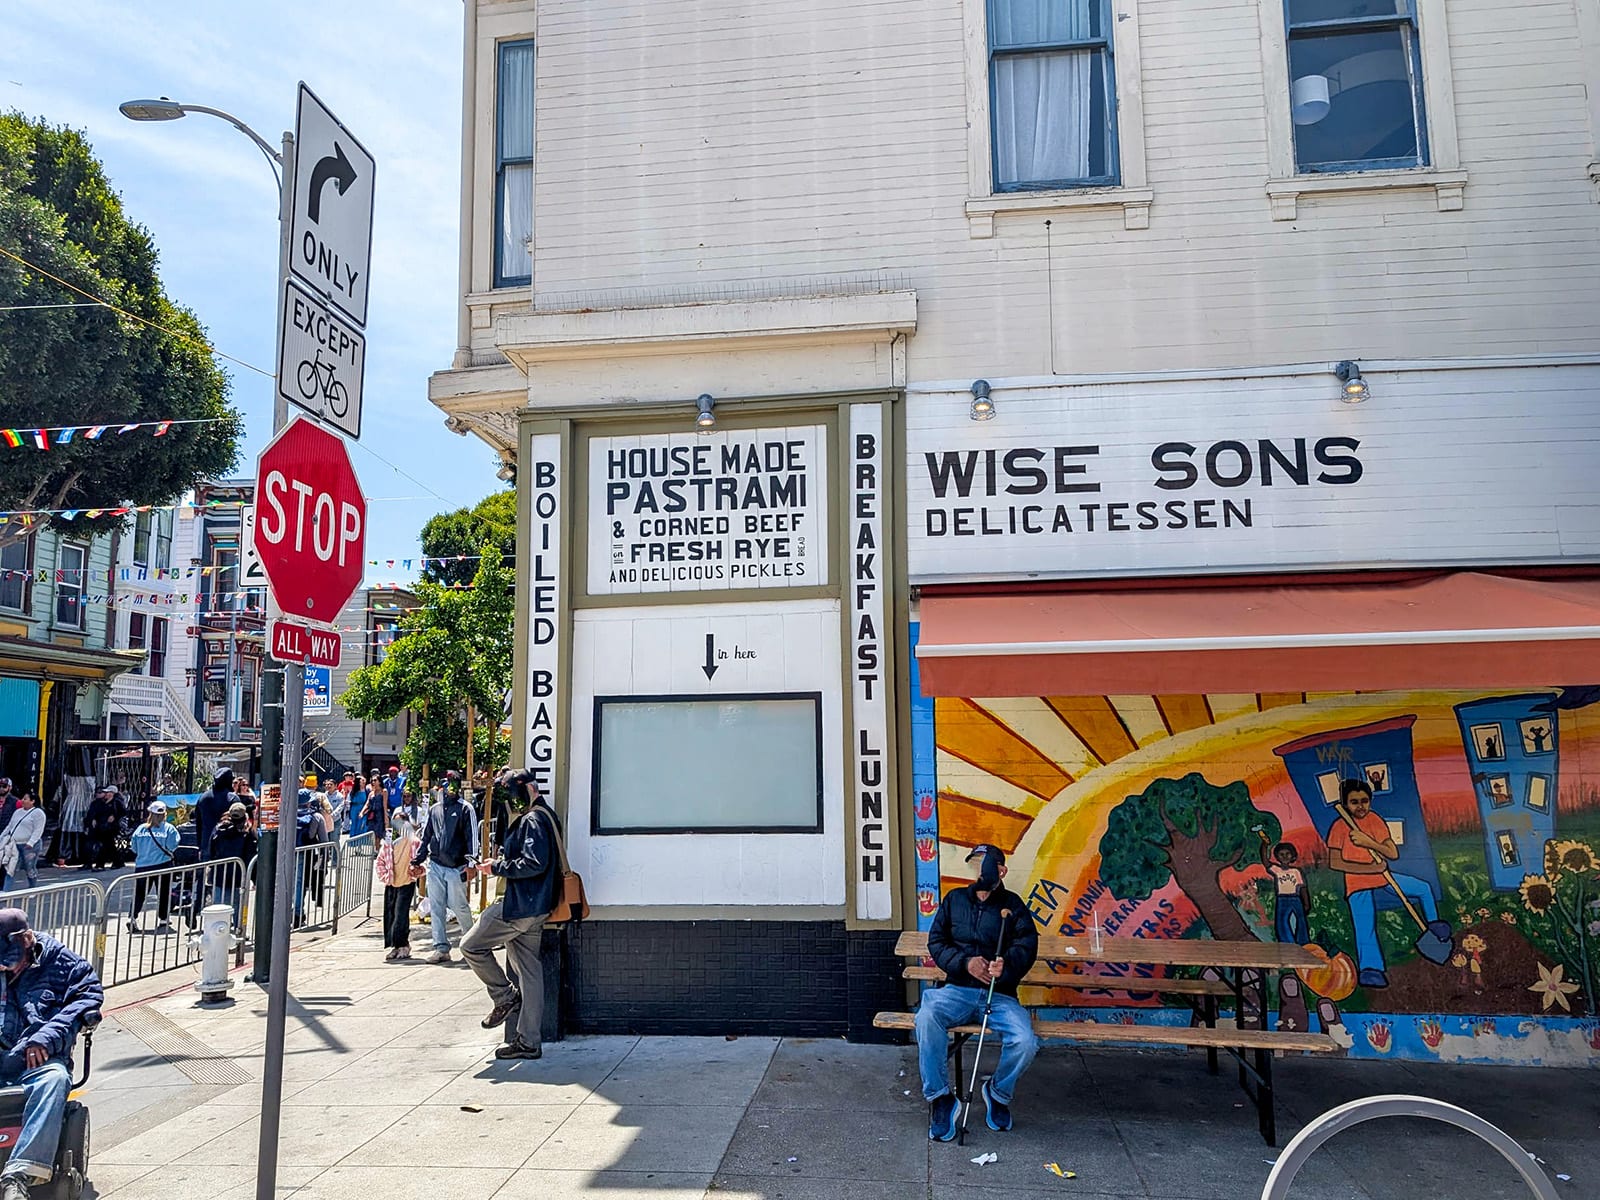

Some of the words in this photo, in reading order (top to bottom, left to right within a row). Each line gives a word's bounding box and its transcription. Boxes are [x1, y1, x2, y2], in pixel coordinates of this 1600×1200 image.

[303, 231, 359, 299] ONLY
[293, 298, 359, 366] EXCEPT
[608, 445, 712, 479] HOUSE
[721, 441, 806, 474] MADE
[925, 445, 1102, 498] WISE
[1151, 437, 1363, 491] SONS
[260, 470, 361, 567] STOP
[607, 474, 807, 515] PASTRAMI
[926, 498, 1253, 537] DELICATESSEN
[613, 520, 625, 539] &
[639, 516, 730, 537] CORNED
[745, 513, 805, 533] BEEF
[613, 550, 624, 559] on
[630, 540, 722, 563] FRESH
[735, 538, 791, 559] RYE
[797, 536, 806, 557] BREAD
[534, 461, 557, 645] BOILED
[609, 568, 637, 583] AND
[642, 565, 724, 582] DELICIOUS
[731, 562, 806, 578] PICKLES
[855, 434, 877, 700] BREAKFAST
[277, 629, 302, 655] ALL
[311, 636, 337, 660] WAY
[718, 648, 729, 660] in
[734, 644, 757, 660] here
[530, 669, 554, 796] BAGE
[861, 730, 883, 882] LUNCH
